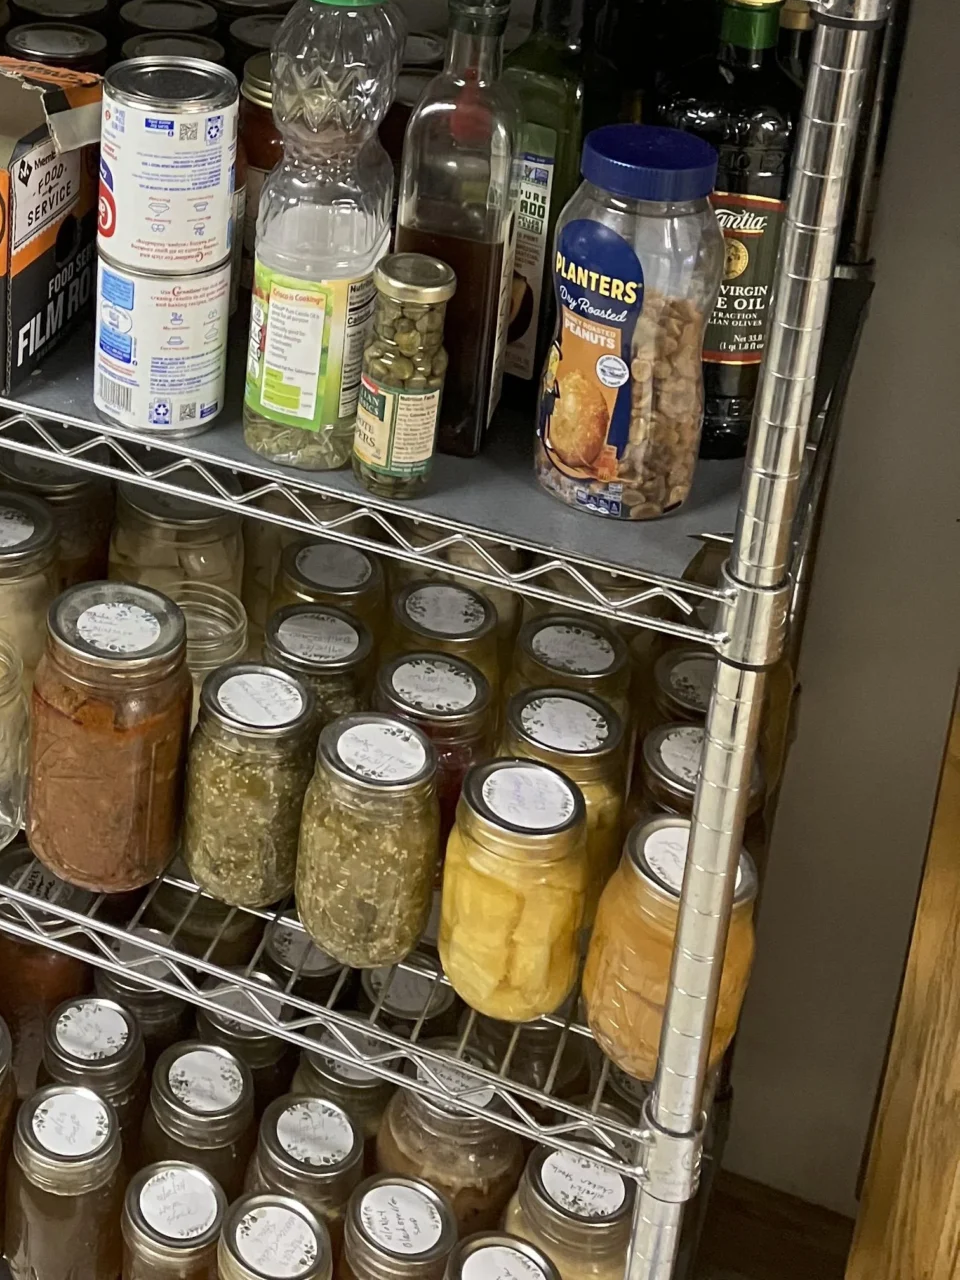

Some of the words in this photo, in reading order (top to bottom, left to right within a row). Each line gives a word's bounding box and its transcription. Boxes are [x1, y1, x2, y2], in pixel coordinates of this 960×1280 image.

[38, 161, 64, 191] FOOD
[27, 180, 72, 227] SERVICE
[48, 263, 75, 299] FOOD
[555, 251, 638, 305] PLANTERS
[720, 285, 769, 297] VIRGIN
[559, 285, 578, 310] Dry
[577, 297, 628, 323] Roasted
[733, 297, 766, 310] OIL
[16, 291, 64, 368] FILM
[564, 317, 616, 350] PEANUTS
[582, 321, 617, 339] ROASTED
[731, 318, 763, 327] OLIVES
[733, 334, 747, 343] Net
